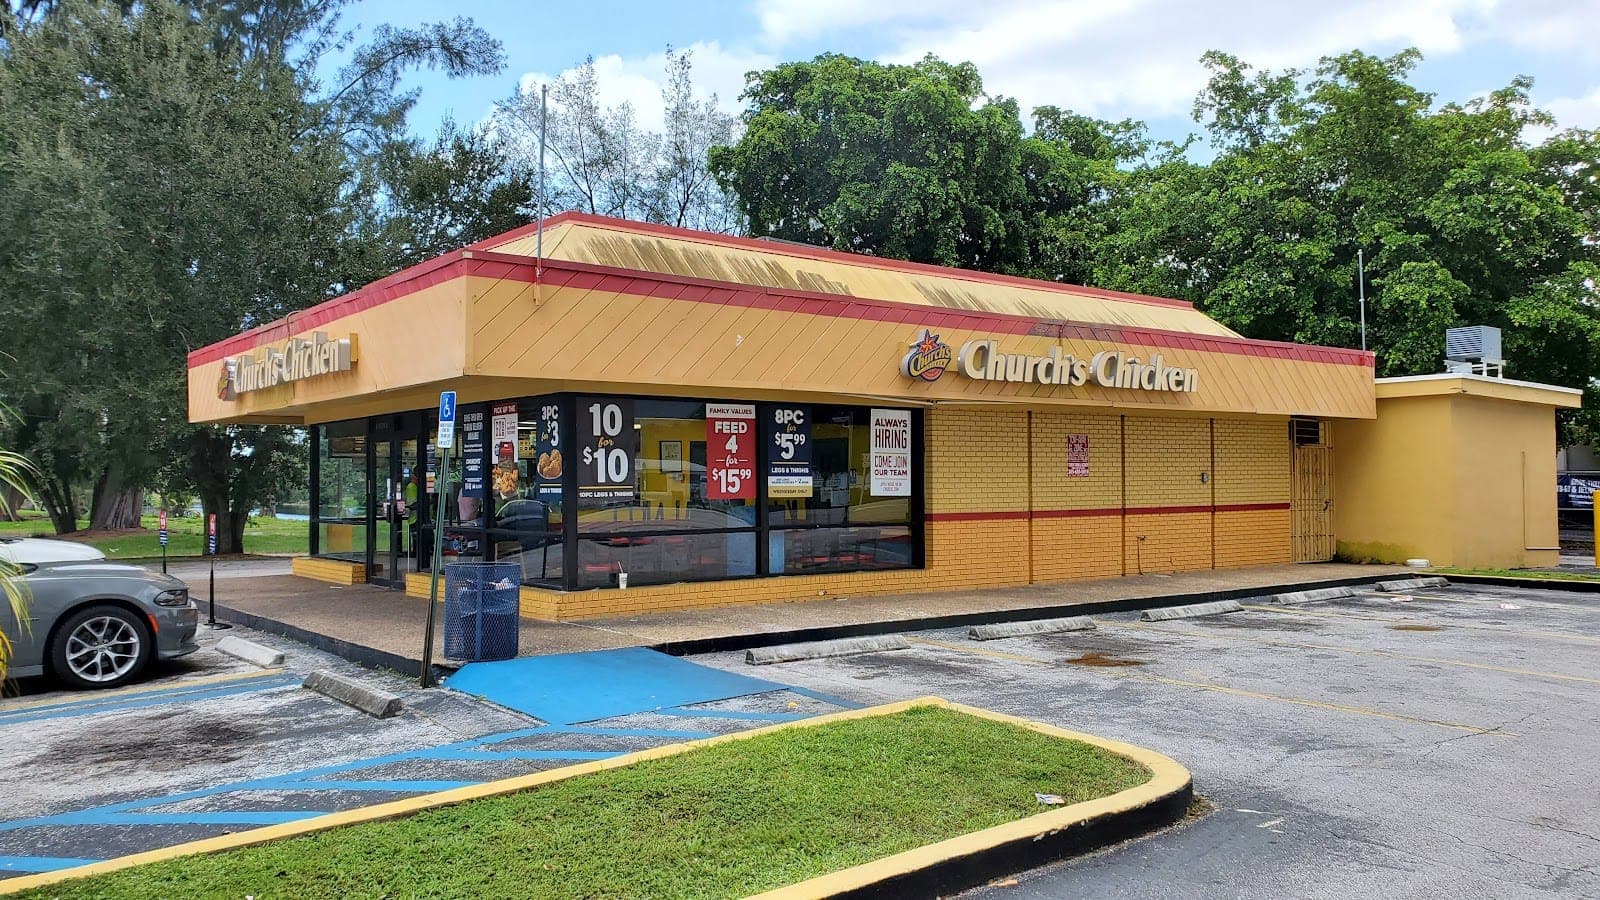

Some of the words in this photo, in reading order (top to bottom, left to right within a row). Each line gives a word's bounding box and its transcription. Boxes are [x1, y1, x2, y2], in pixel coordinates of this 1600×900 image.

[282, 330, 340, 382] Chicken
[962, 339, 1088, 387] Church's
[1094, 350, 1199, 392] Chicken
[541, 405, 559, 421] 3PC
[709, 407, 728, 415] FAMILY
[731, 407, 752, 415] VALUES
[774, 409, 805, 424] 8PC
[589, 403, 623, 437] 10
[786, 423, 797, 432] for
[874, 417, 908, 428] ALWAYS
[547, 420, 559, 447] $3
[714, 422, 748, 434] FEED
[598, 437, 615, 447] for
[725, 434, 738, 454] 4
[874, 428, 907, 449] HIRING
[583, 446, 629, 483] $10
[725, 454, 738, 467] for
[874, 455, 892, 467] COME
[893, 455, 907, 468] JOIN
